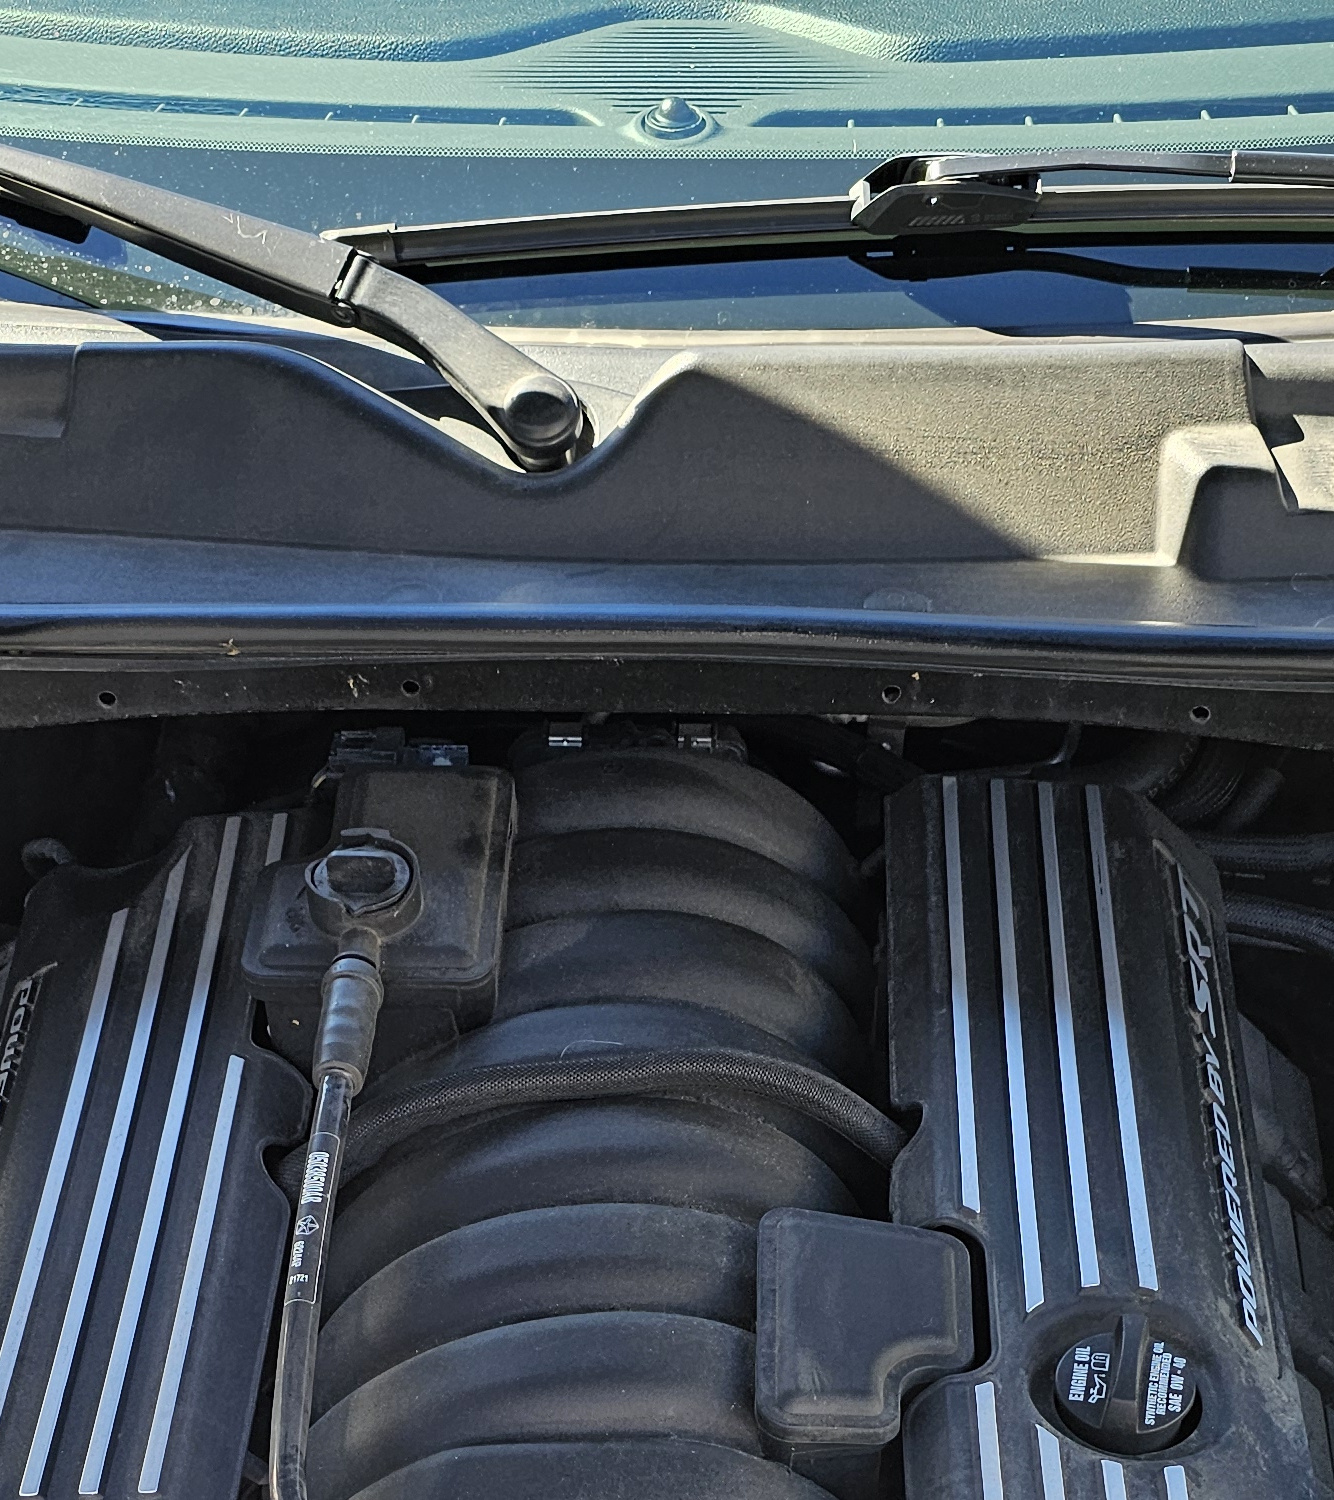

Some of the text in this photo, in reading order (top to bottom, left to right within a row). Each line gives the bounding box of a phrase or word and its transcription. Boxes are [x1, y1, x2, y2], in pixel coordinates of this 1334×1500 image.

[1177, 863, 1264, 1347] POWERED BY SRT
[1068, 1345, 1091, 1401] ENGINE OIL
[1145, 1341, 1165, 1426] SYNTHETIC ENGINE OIL
[1156, 1352, 1172, 1415] RECOMMENDED
[1173, 1356, 1187, 1369] 40
[1168, 1392, 1183, 1413] SAE
